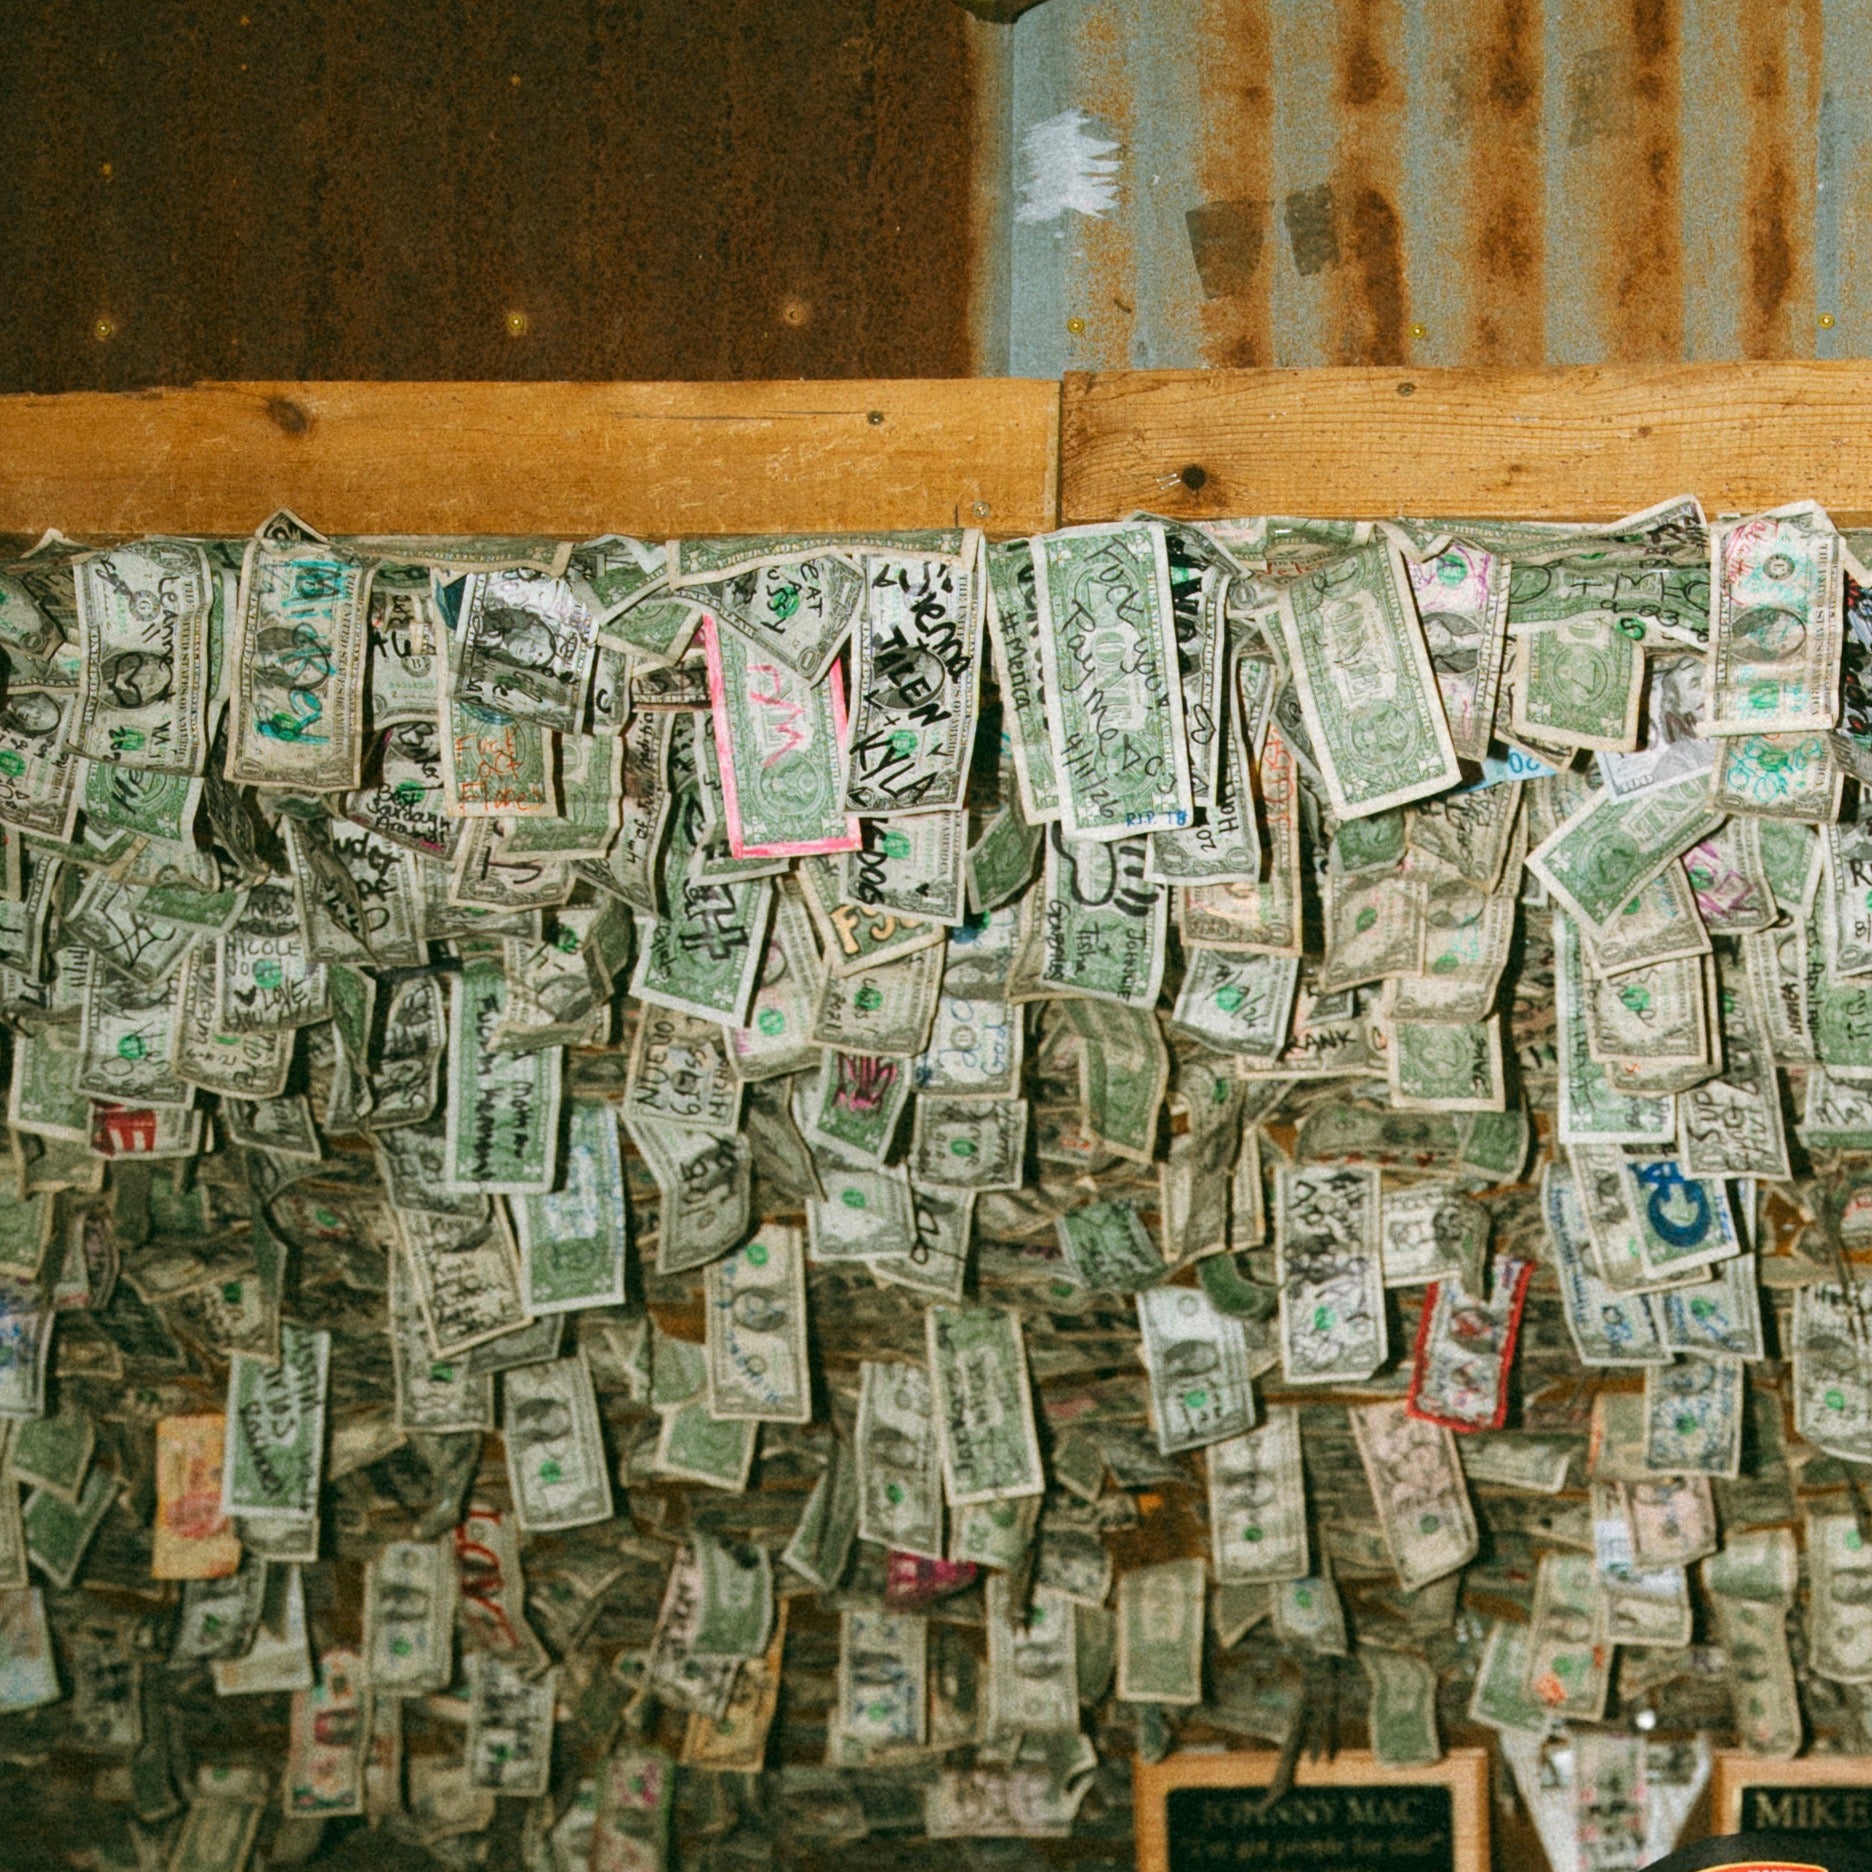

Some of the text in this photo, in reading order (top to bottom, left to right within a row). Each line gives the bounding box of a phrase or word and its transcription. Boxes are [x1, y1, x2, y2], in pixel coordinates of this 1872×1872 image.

[1084, 536, 1143, 626] Fuck
[999, 611, 1032, 712] #Merica
[1753, 1791, 1872, 1830] MIKE
